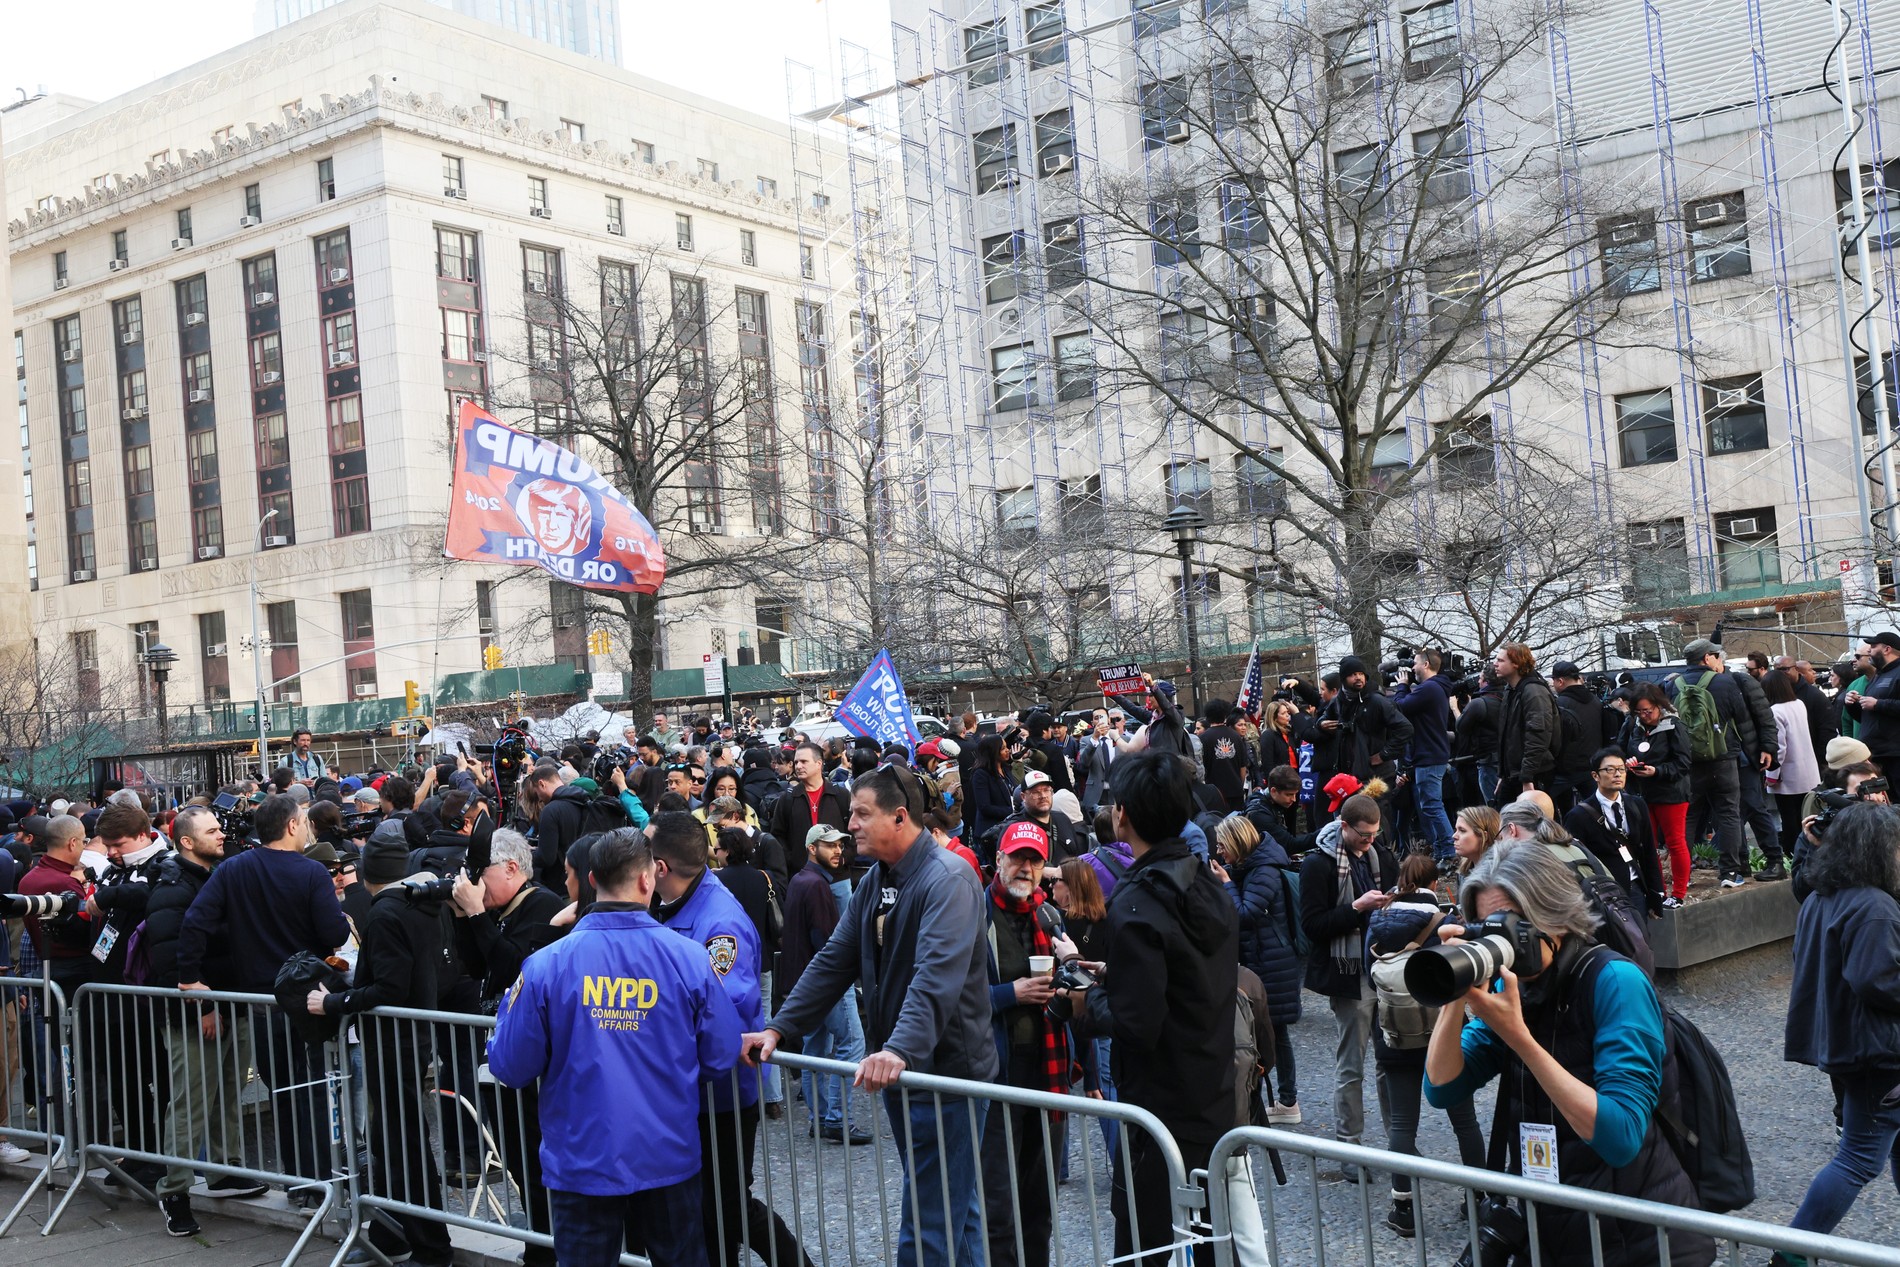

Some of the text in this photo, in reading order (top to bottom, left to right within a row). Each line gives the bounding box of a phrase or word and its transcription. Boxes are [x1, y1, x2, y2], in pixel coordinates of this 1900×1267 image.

[1101, 665, 1139, 680] TRUMP 24
[848, 702, 879, 730] ABOUT
[1018, 824, 1038, 833] SAVE
[1011, 831, 1044, 845] AMERICA
[583, 975, 658, 1009] NYPD
[591, 1008, 648, 1020] COMMUNITY
[598, 1020, 639, 1031] AFFAIRS
